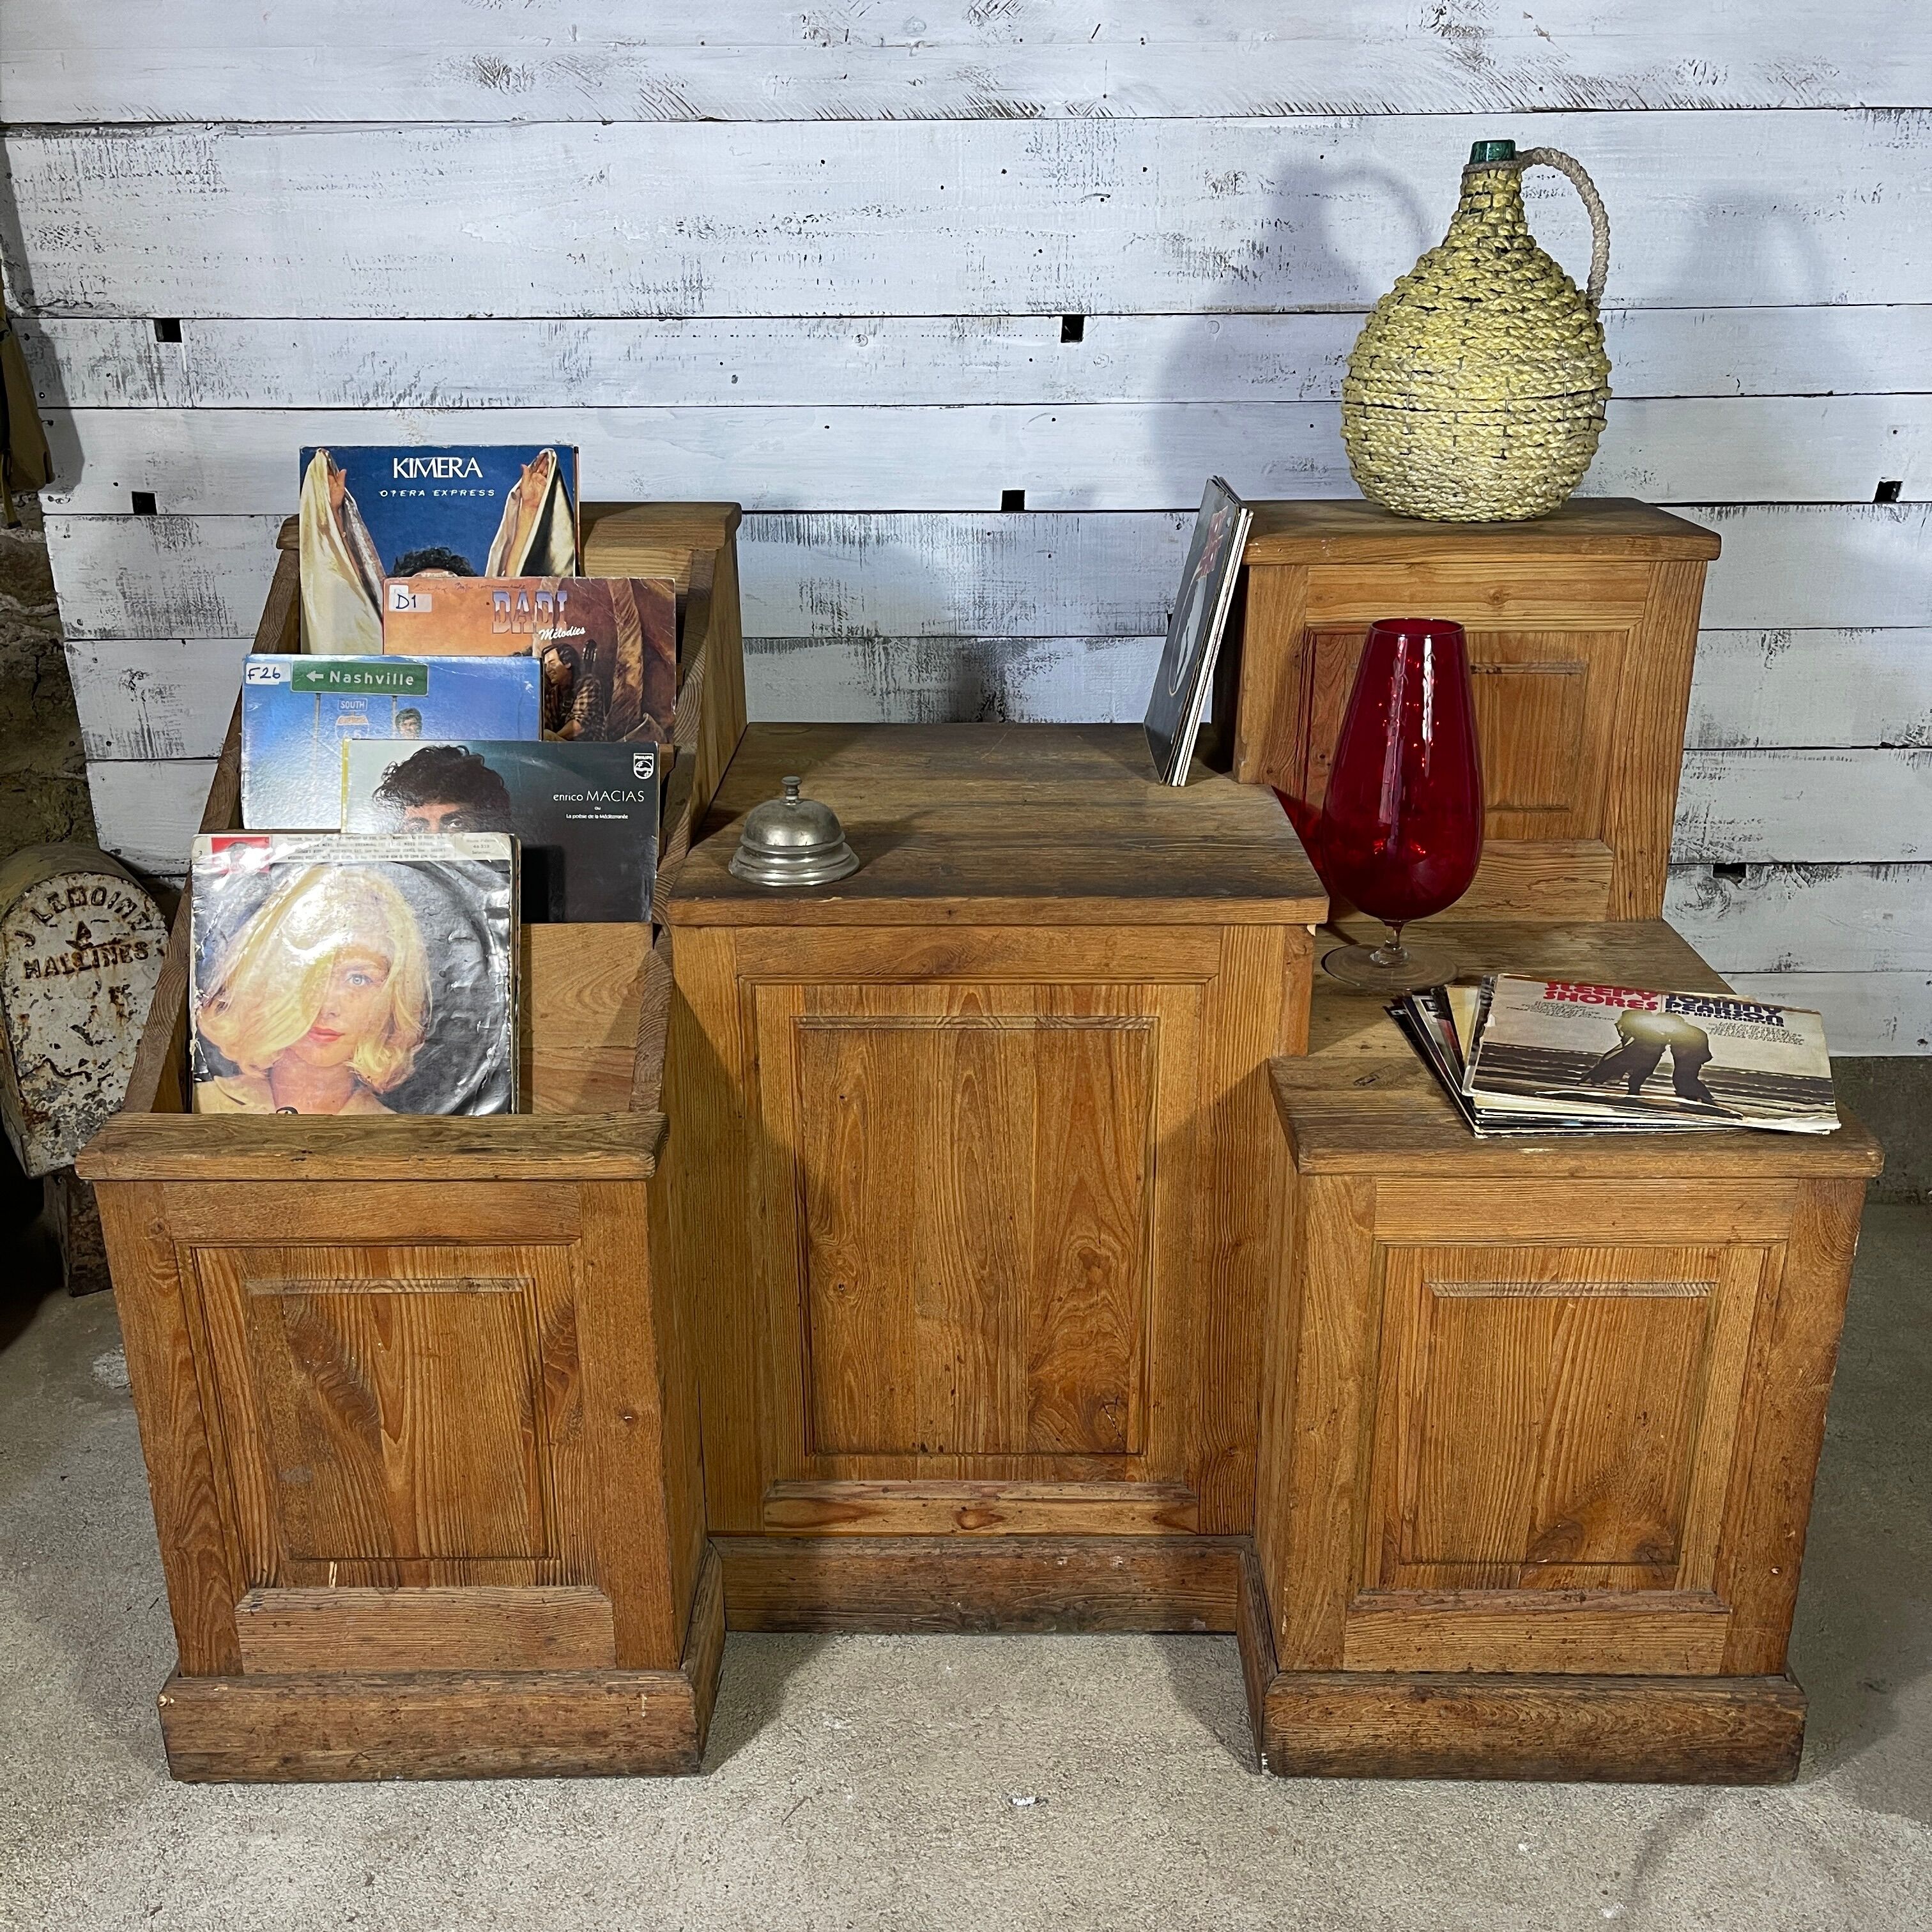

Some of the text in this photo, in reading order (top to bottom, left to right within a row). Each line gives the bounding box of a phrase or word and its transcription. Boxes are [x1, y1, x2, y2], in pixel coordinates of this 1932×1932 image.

[393, 456, 484, 479] KIMERA
[433, 489, 495, 497] EXPRESS
[395, 593, 417, 610] D1
[492, 589, 569, 634] DADI
[538, 625, 586, 641] Mélodies
[247, 666, 281, 680] F26
[329, 670, 415, 686] Nashville
[340, 700, 365, 710] SOUTH
[553, 790, 645, 802] enrico MACIAS
[1544, 981, 1659, 1001] SLEEPY
[1542, 991, 1659, 1011] SHORES
[1665, 1000, 1784, 1024] PEARSON
